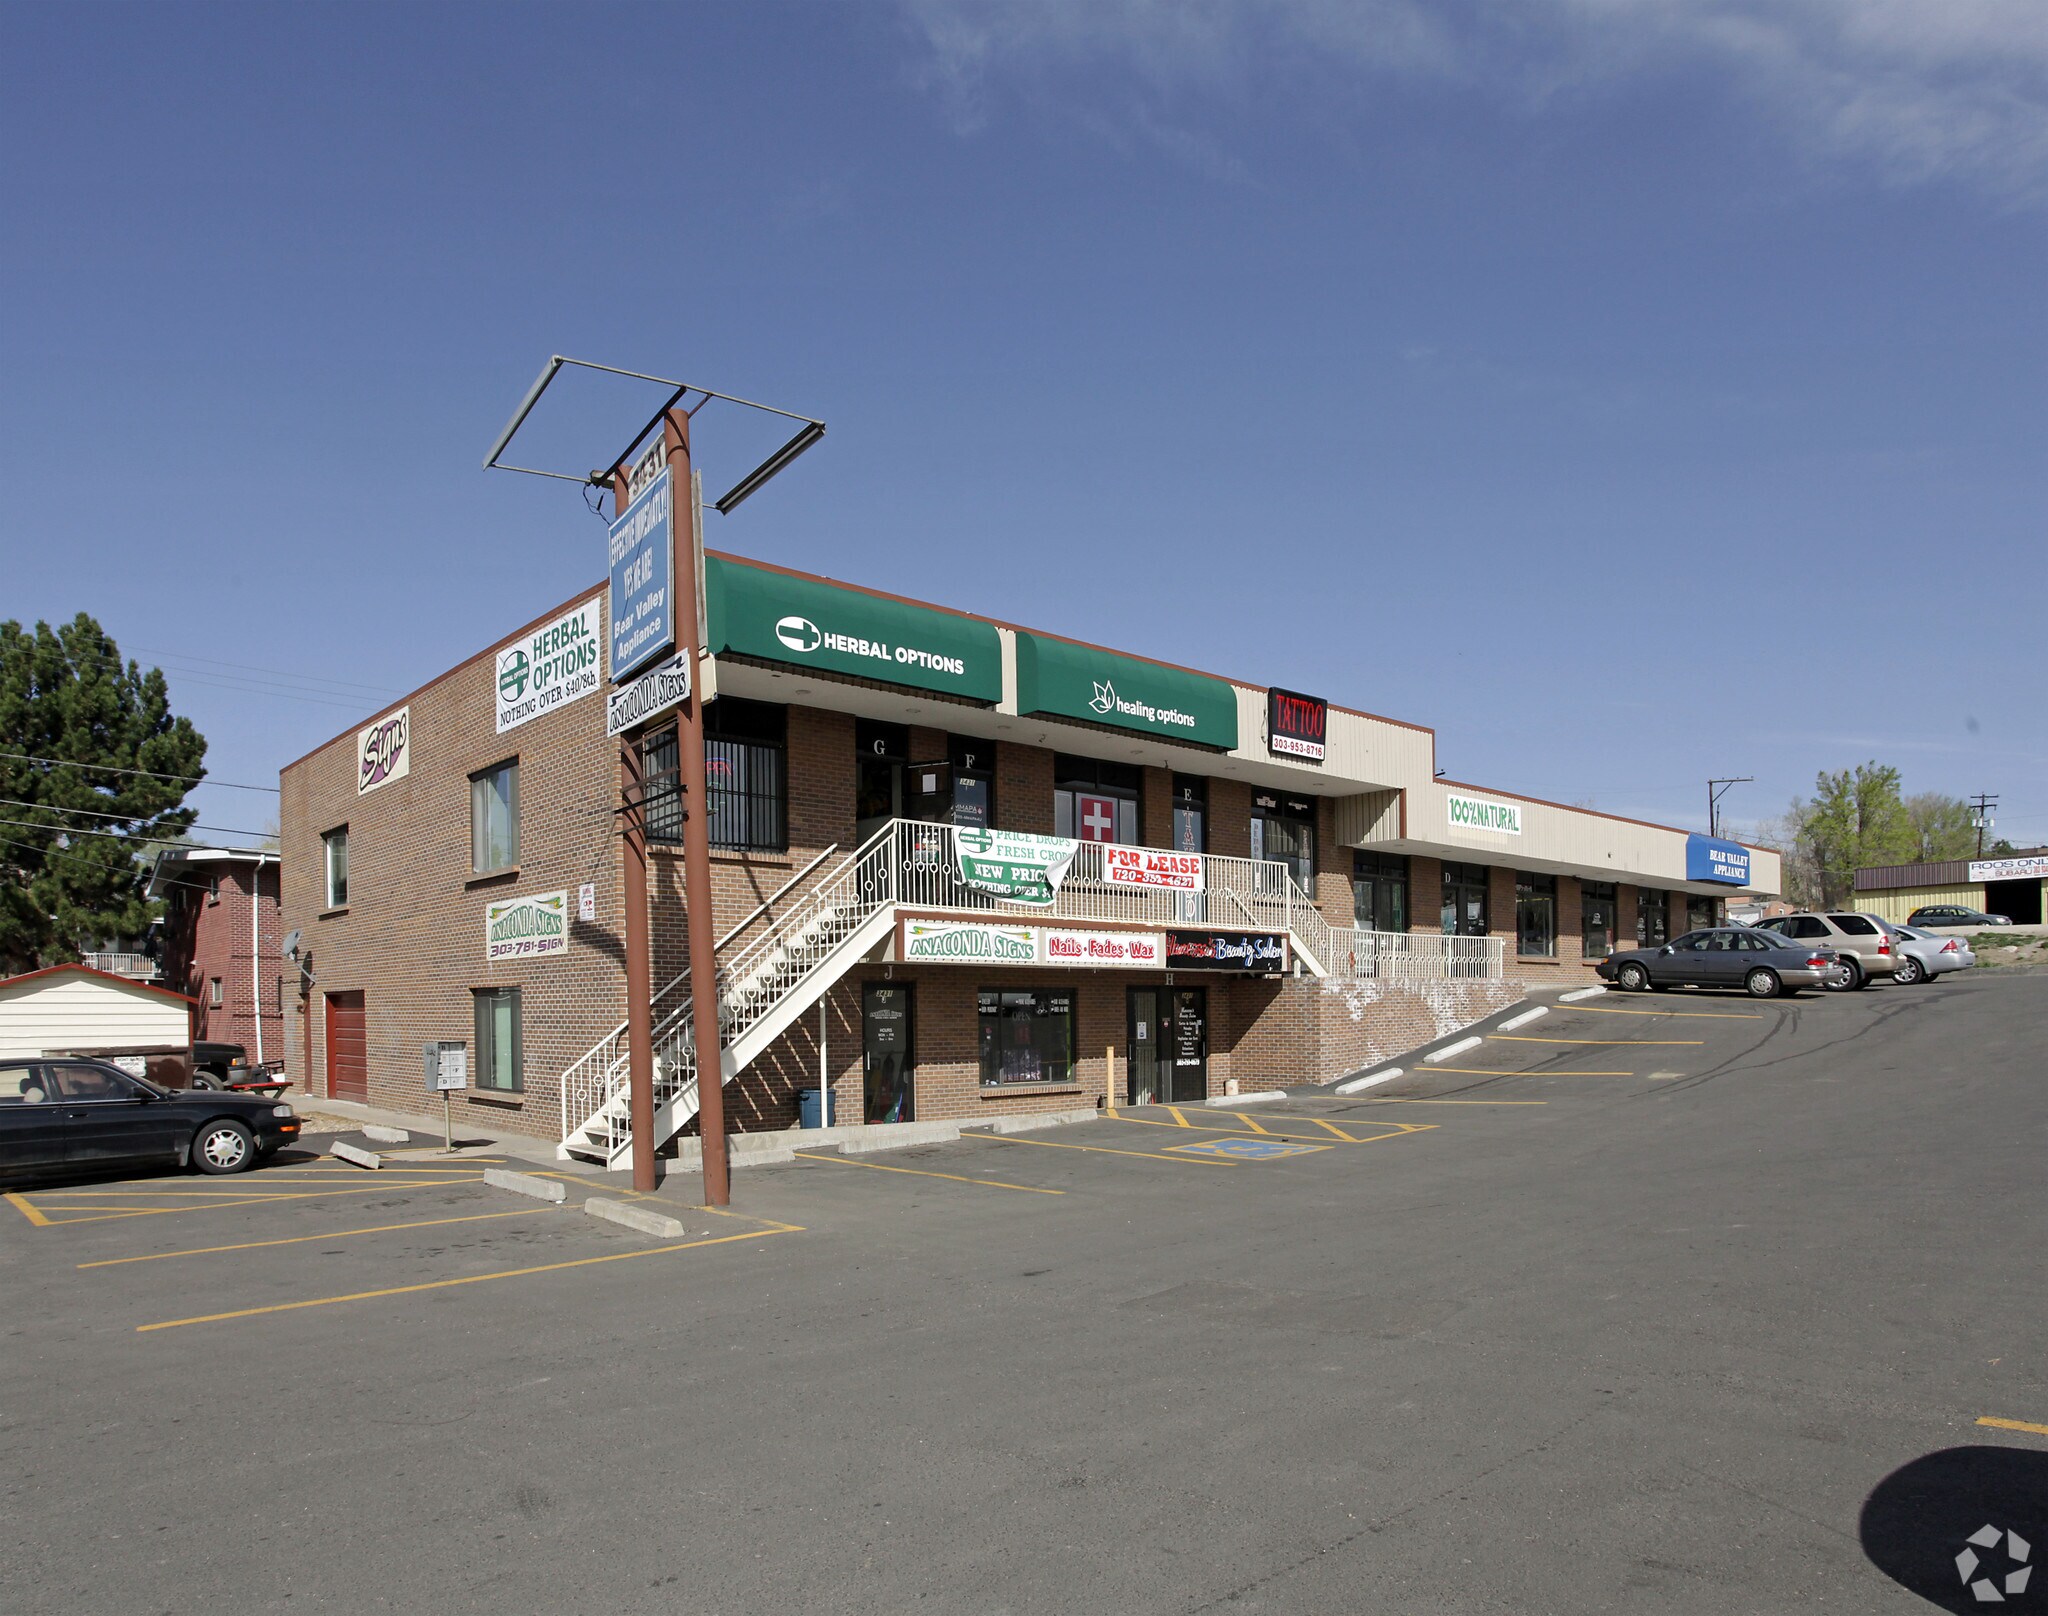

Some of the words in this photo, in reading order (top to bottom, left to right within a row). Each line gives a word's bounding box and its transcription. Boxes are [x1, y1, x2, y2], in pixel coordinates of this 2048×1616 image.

[614, 614, 634, 640] Bear
[636, 587, 664, 621] Valley
[533, 612, 590, 662] HERBAL
[617, 617, 661, 662] Appliance
[533, 638, 597, 691] OPTIONS
[823, 632, 892, 661] HERBAL
[895, 646, 965, 675] OPTIONS
[500, 698, 536, 727] NOTHING
[540, 685, 563, 708] OVER
[609, 674, 659, 733] ANACONDA
[658, 672, 686, 705] SIGNS
[1116, 696, 1155, 722] healing
[1156, 707, 1195, 728] options
[1276, 694, 1324, 738] TATTOO
[360, 713, 406, 792] Signs
[873, 739, 886, 755] G
[1273, 737, 1323, 757] 303-953-8716
[964, 753, 976, 769] F
[1183, 788, 1192, 801] E
[996, 830, 1032, 843] PRICE
[1036, 834, 1071, 847] DROPS
[996, 844, 1035, 860] FRESH
[1108, 848, 1141, 869] FOR
[1146, 854, 1200, 875] LEASE
[1709, 849, 1726, 863] BEAR
[1726, 852, 1749, 867] VALLEY
[974, 861, 1004, 879] NEW
[1712, 863, 1746, 879] APPLIANCE
[1971, 860, 2014, 870] ROOS
[2017, 857, 2048, 867] ONL
[968, 878, 1012, 894] NOTHING
[1014, 885, 1039, 897] OVER
[1444, 872, 1451, 883] D
[491, 905, 536, 942] ANACONDA
[536, 908, 562, 936] SIGNS
[490, 938, 564, 958] 303-781-SIGN
[910, 929, 992, 957] ANACONDA
[994, 934, 1035, 960] SIGNS
[1050, 936, 1083, 957] Nails
[1087, 938, 1125, 958] Fades
[1128, 940, 1155, 960] Wax
[1215, 937, 1255, 967] Beauty
[1254, 936, 1284, 960] Salon
[884, 965, 893, 980] J
[1165, 972, 1174, 986] H
